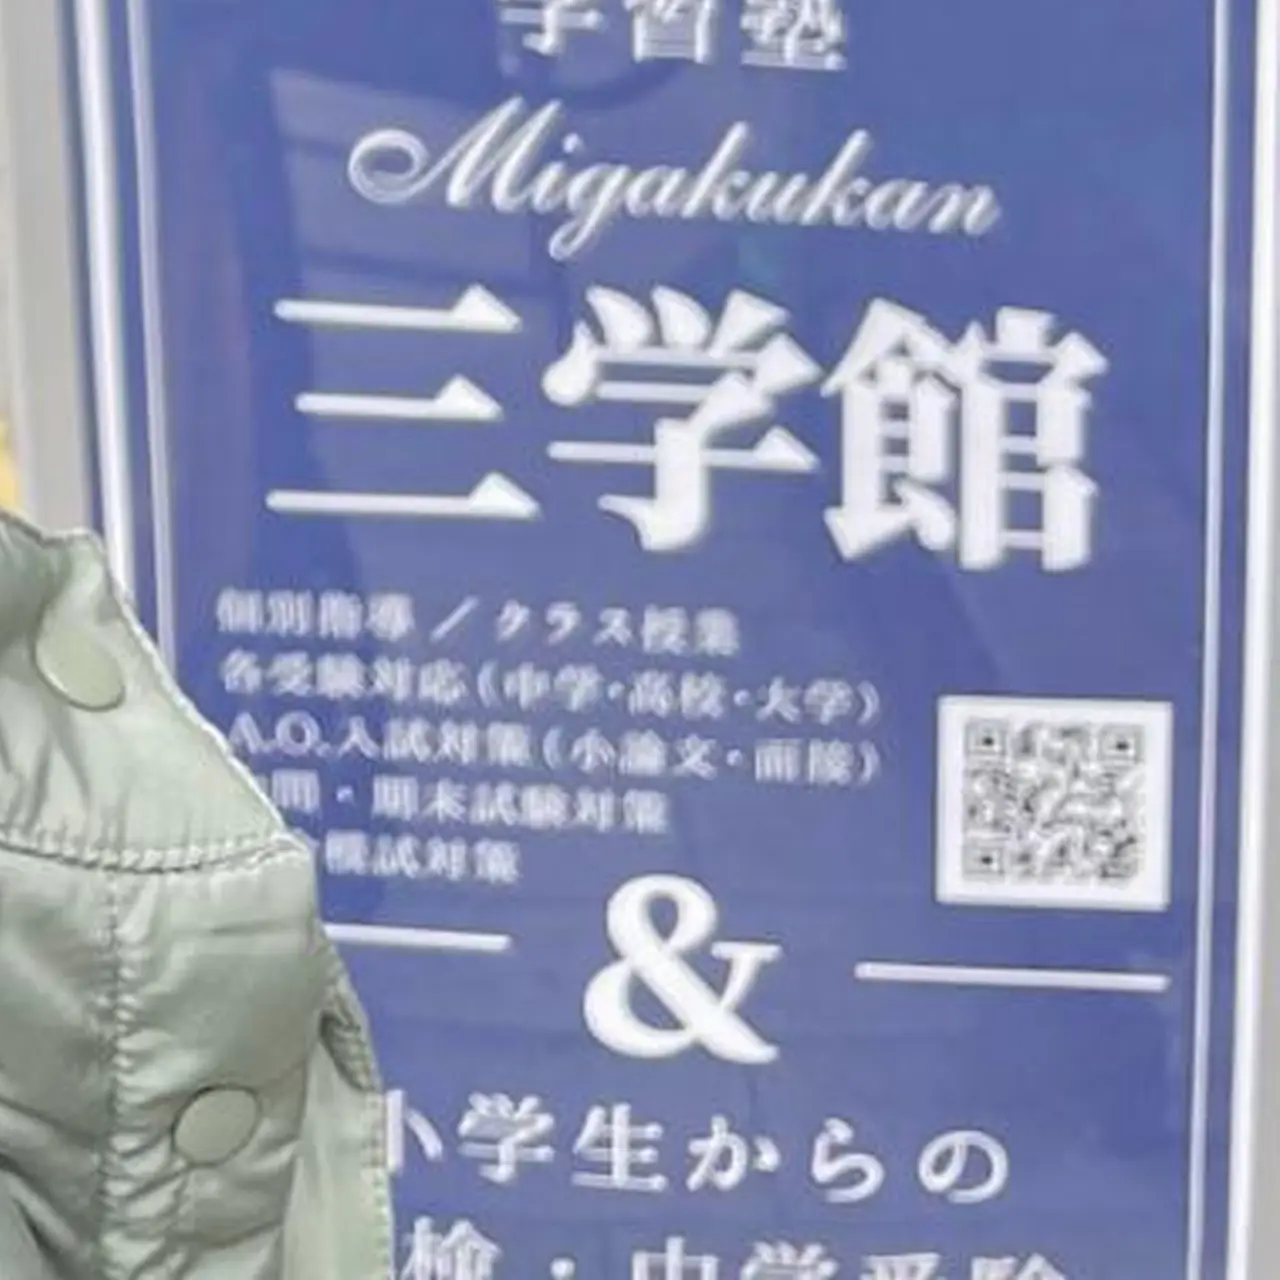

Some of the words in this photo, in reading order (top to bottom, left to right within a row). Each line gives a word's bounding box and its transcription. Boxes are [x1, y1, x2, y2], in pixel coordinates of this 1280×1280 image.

[347, 96, 1002, 260] Migakukan
[265, 283, 1110, 570] 三学館
[255, 769, 671, 835] 間・期末試験対策
[582, 871, 784, 1064] &
[385, 1088, 1010, 1203] 小学生からの
